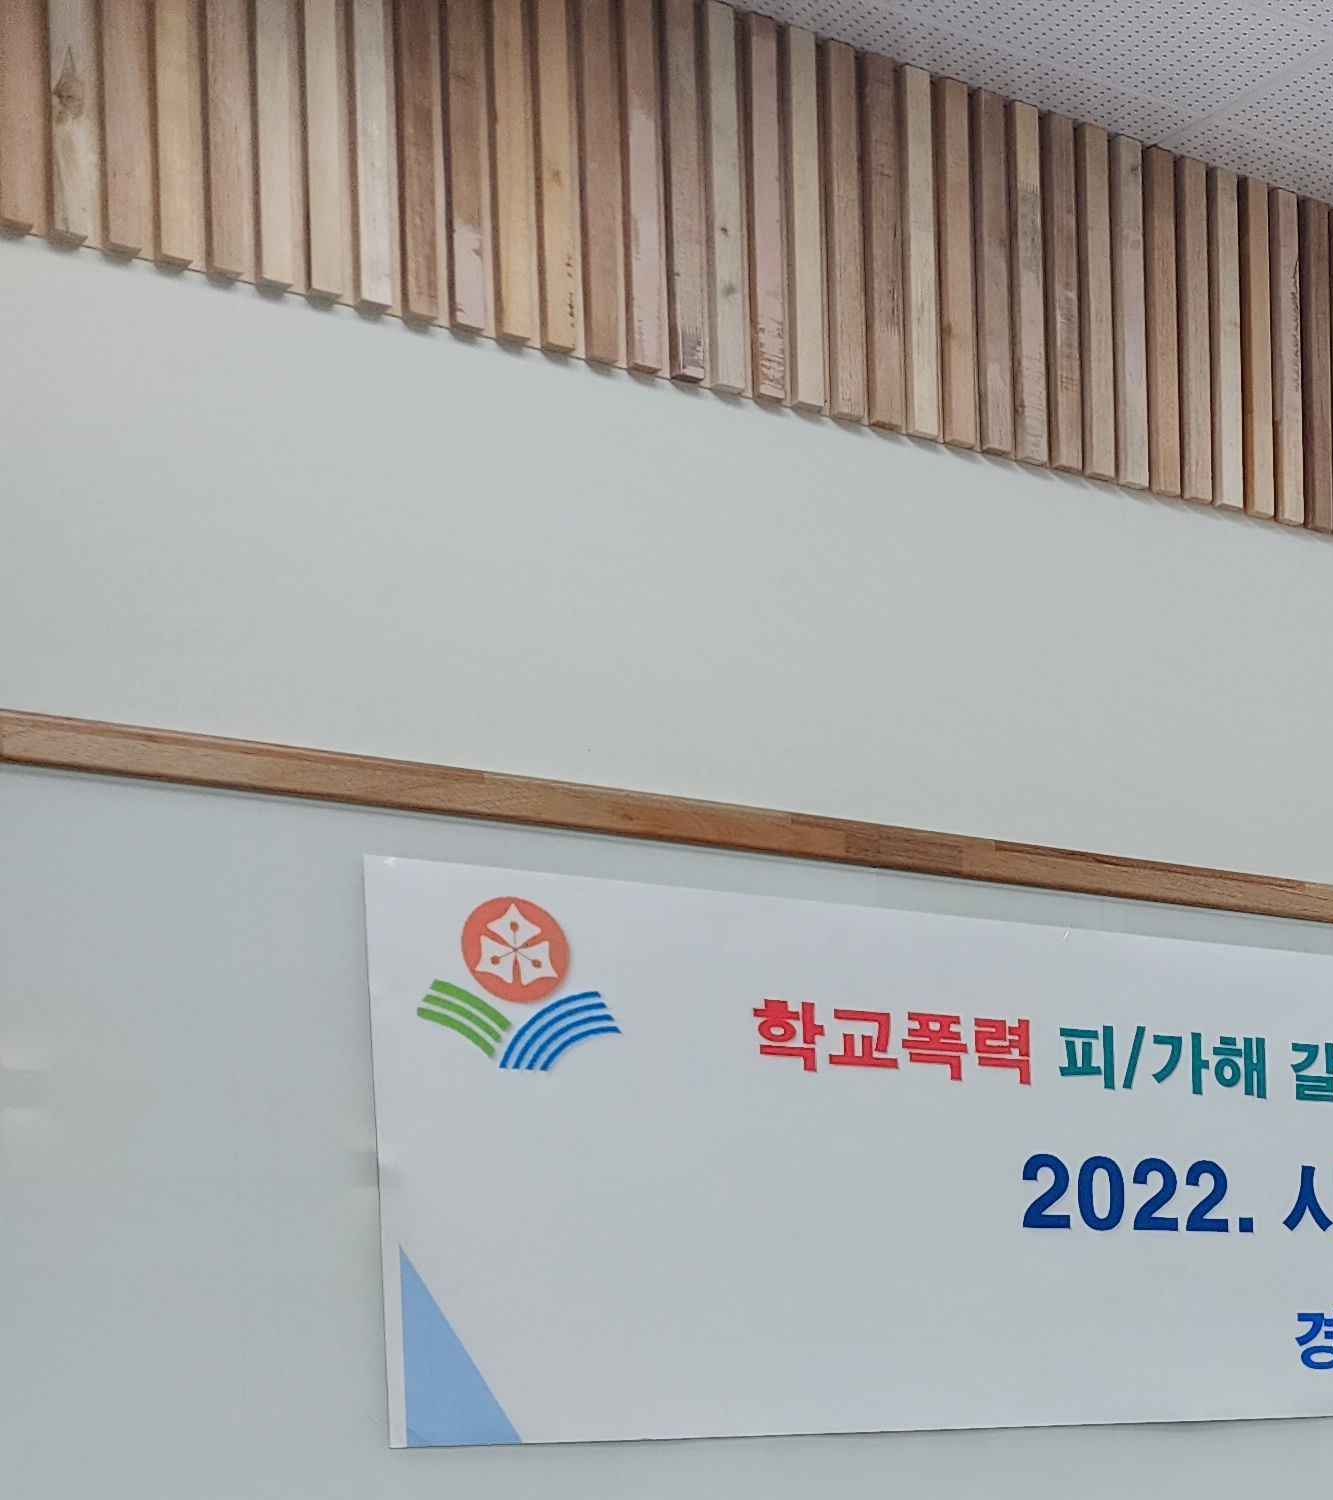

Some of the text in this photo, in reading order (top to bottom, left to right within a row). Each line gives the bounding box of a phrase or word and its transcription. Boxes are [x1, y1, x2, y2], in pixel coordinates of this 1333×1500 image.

[752, 998, 1031, 1086] 학교폭력
[1058, 1024, 1268, 1100] 피/가해
[1022, 1153, 1255, 1235] 2022.
